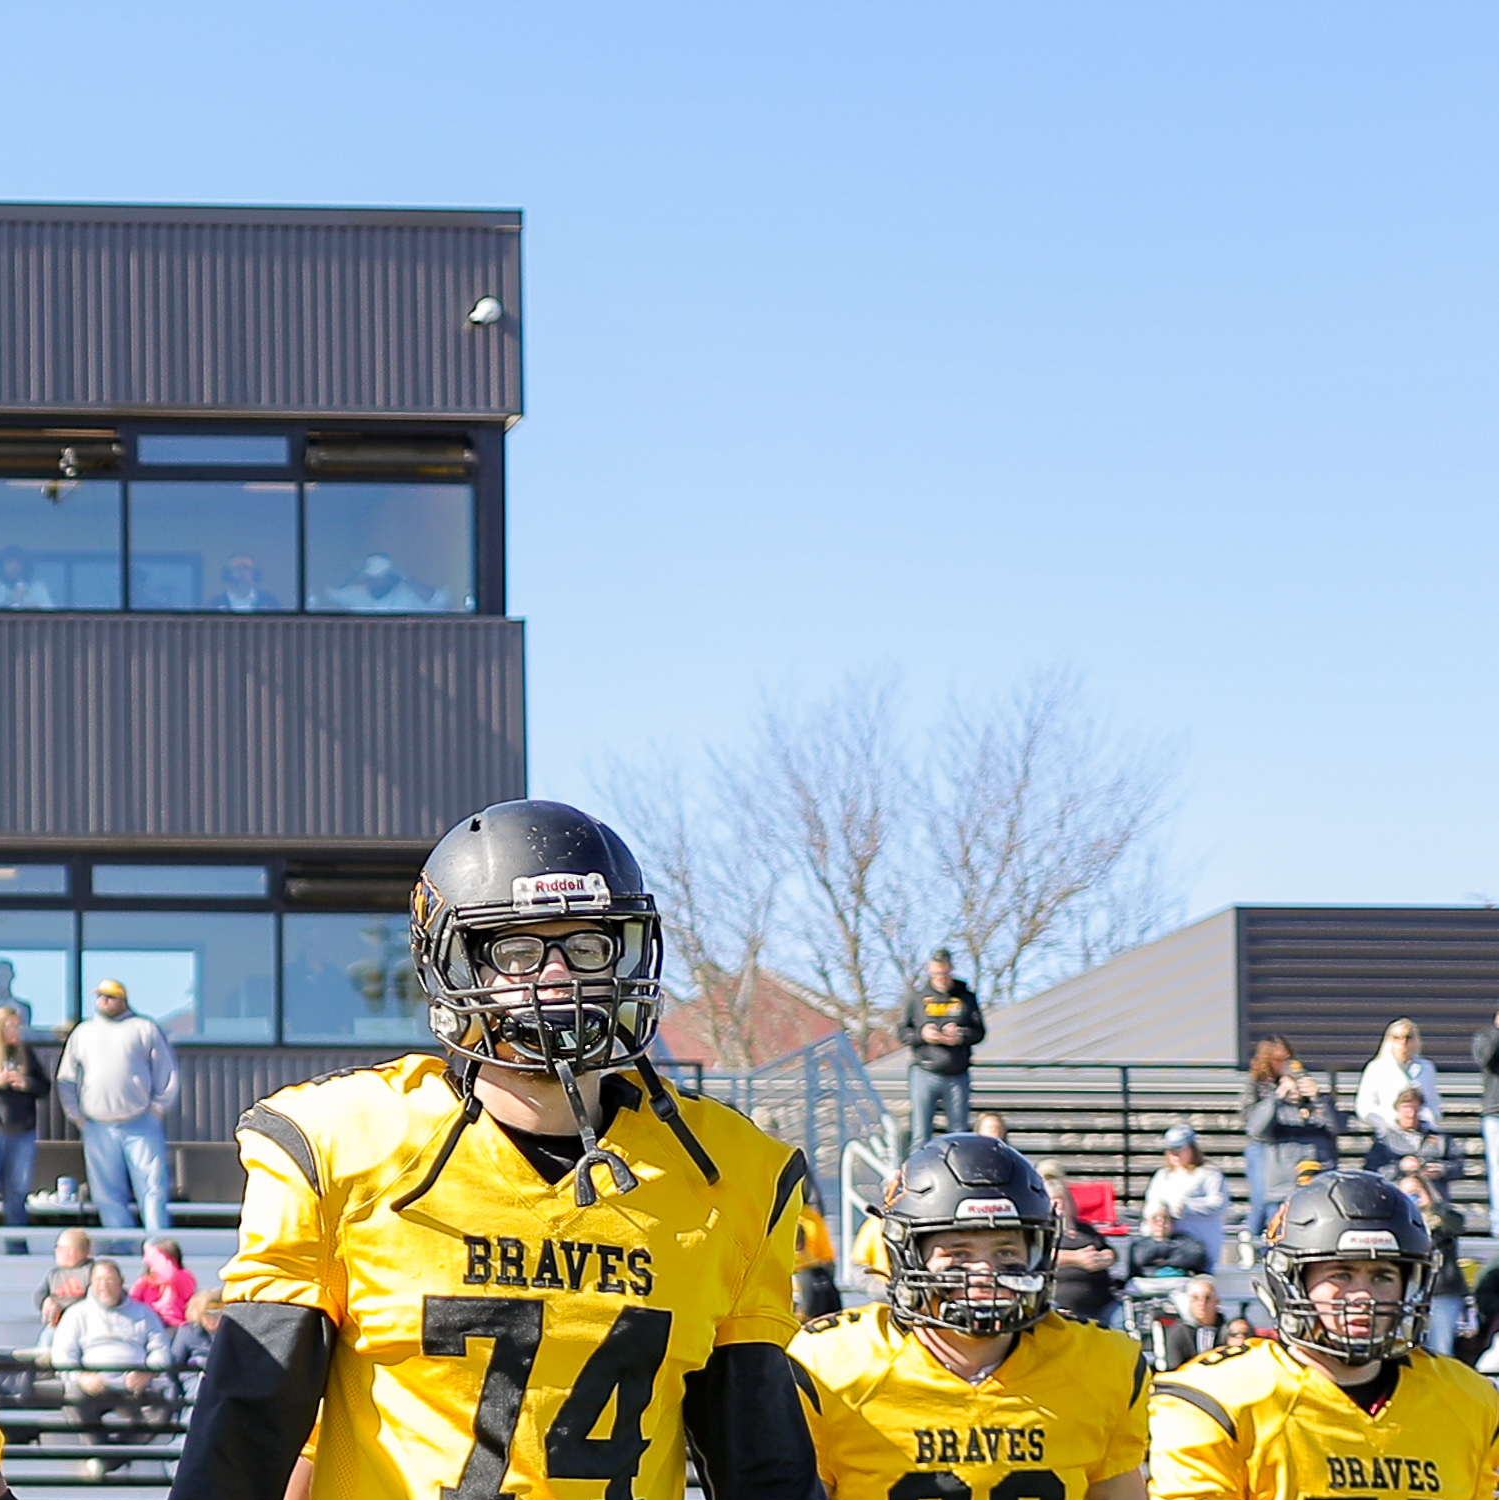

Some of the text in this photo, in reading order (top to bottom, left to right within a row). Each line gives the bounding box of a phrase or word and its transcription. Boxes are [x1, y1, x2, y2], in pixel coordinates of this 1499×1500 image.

[535, 879, 584, 892] Riddell
[464, 1235, 653, 1297] BRAVES
[915, 1427, 1045, 1464] BRAVES
[1327, 1457, 1440, 1492] BRAVES
